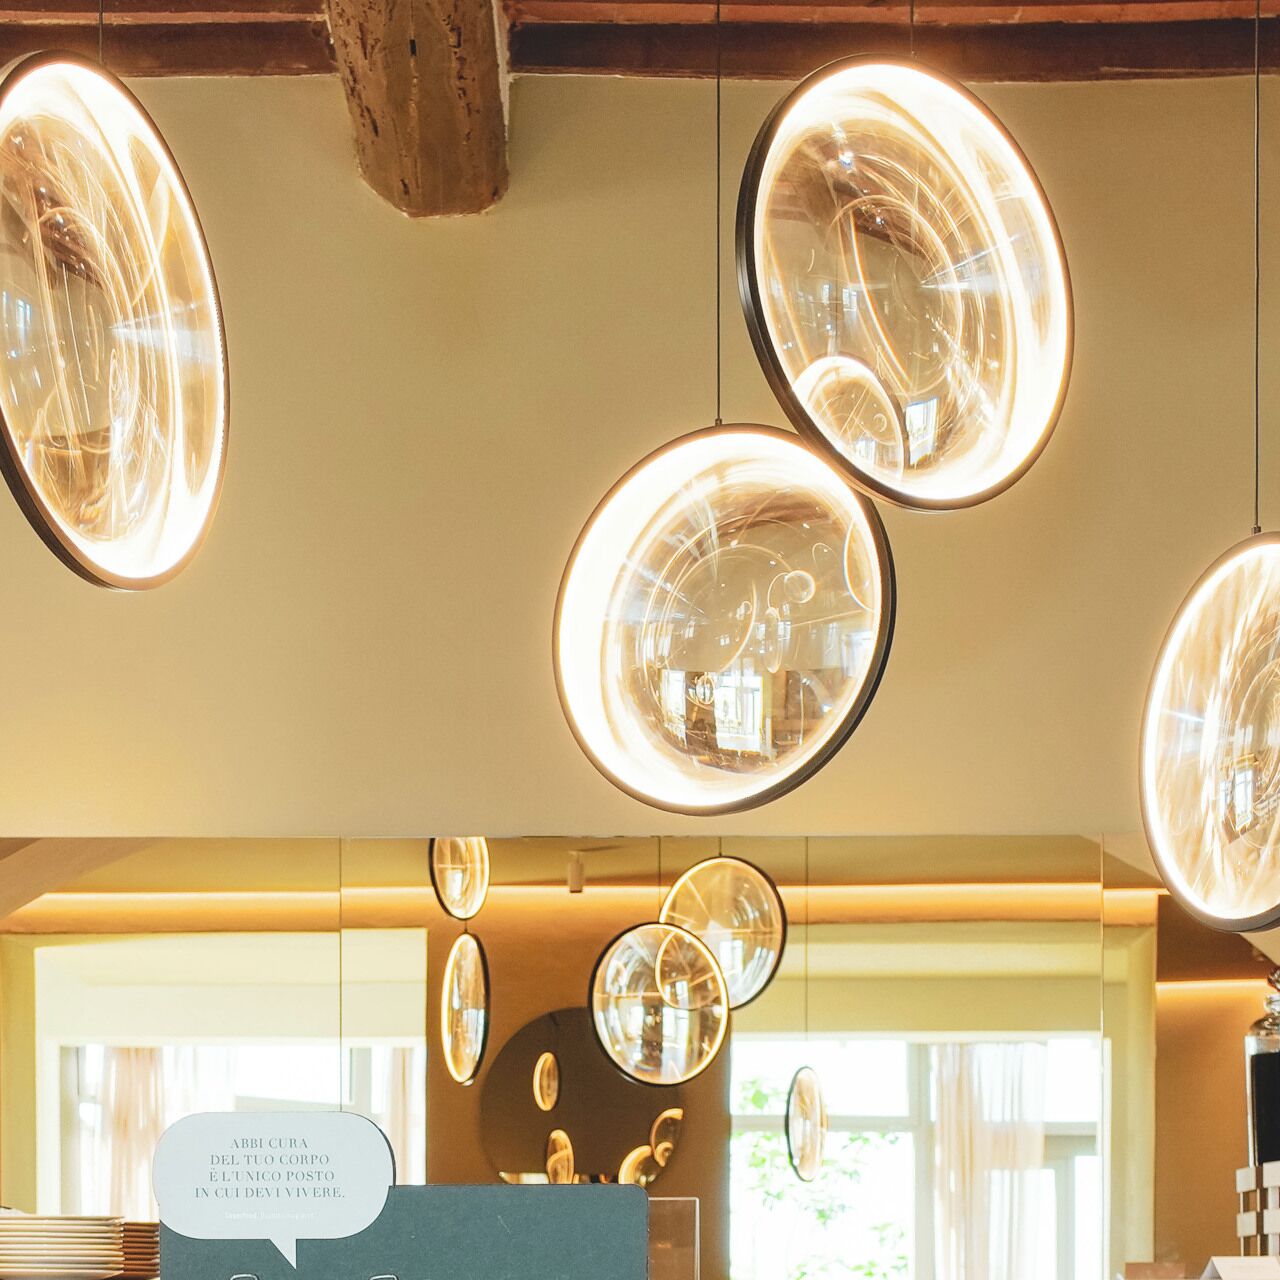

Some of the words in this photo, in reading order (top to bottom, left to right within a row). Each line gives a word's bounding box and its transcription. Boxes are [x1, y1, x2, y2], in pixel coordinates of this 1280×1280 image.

[230, 1138, 263, 1149] ABBI
[269, 1138, 309, 1149] CURA
[210, 1154, 239, 1165] DEL
[244, 1154, 275, 1165] TUO
[279, 1154, 330, 1165] CORPO
[222, 1171, 281, 1182] L'UNICO
[286, 1171, 335, 1182] POSTO
[195, 1187, 210, 1198] IN
[215, 1187, 239, 1198] CUI
[245, 1187, 280, 1198] DEVI
[285, 1187, 345, 1198] VIVERE.
